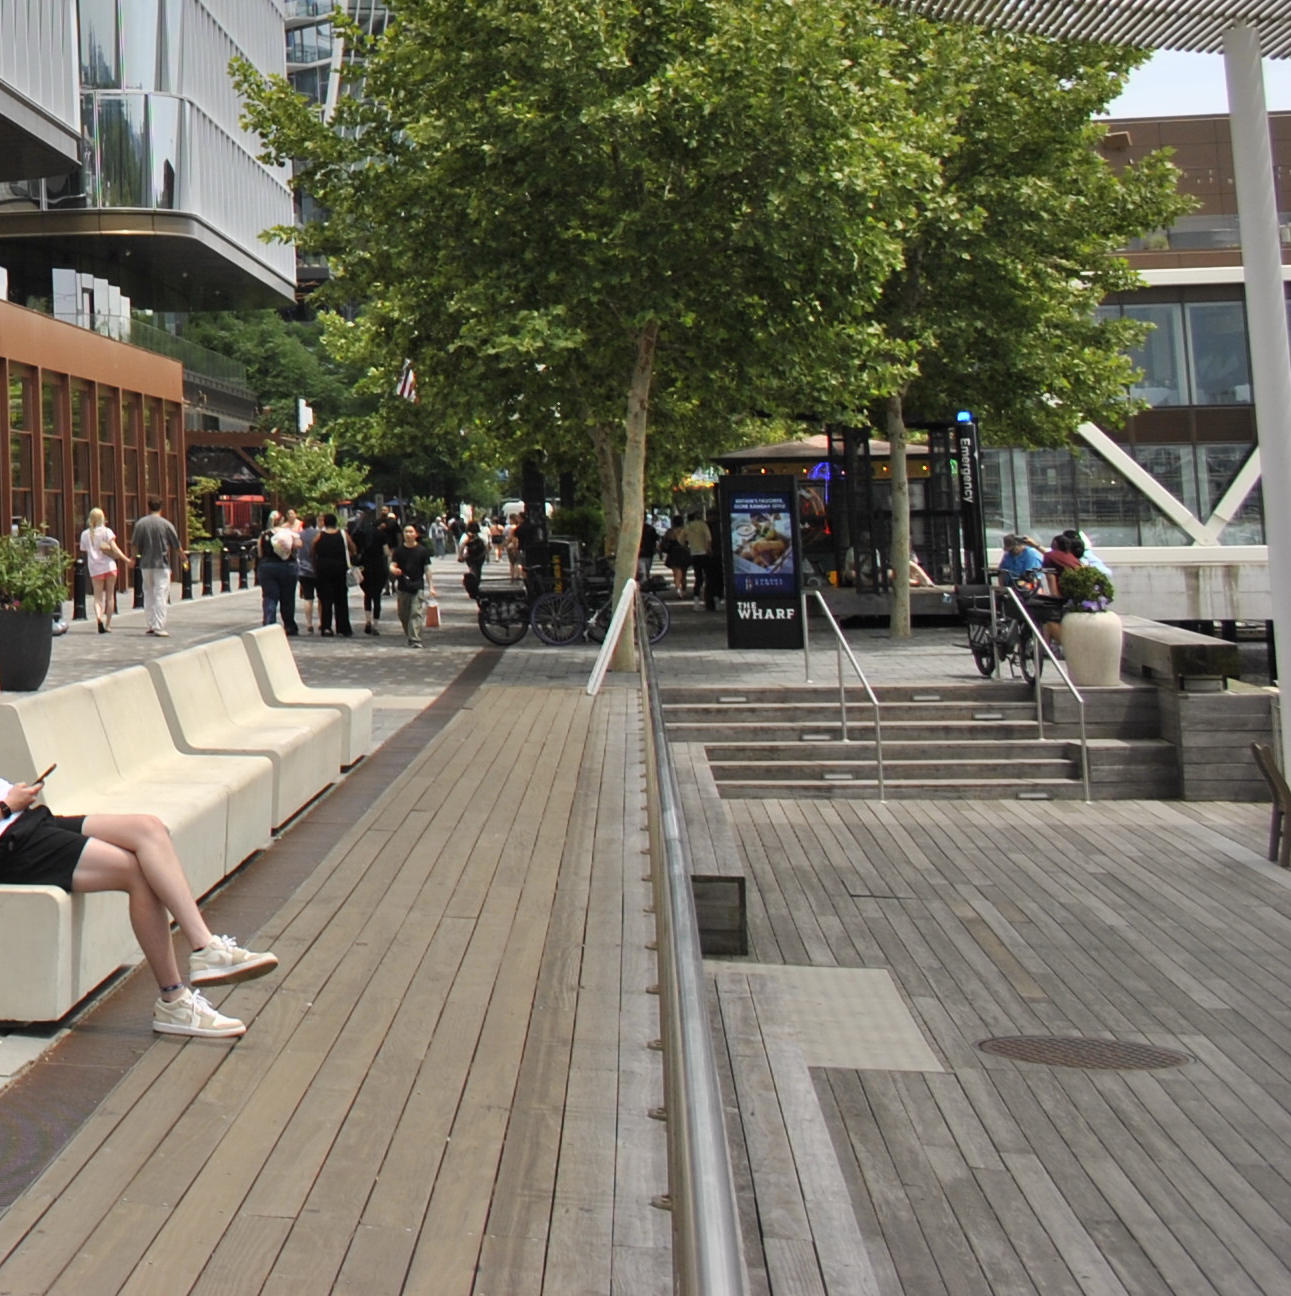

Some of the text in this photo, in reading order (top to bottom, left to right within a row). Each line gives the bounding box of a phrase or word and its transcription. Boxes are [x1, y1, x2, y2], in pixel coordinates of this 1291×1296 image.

[960, 437, 974, 503] Emergency
[737, 601, 757, 610] THE
[738, 608, 795, 620] WHARF
